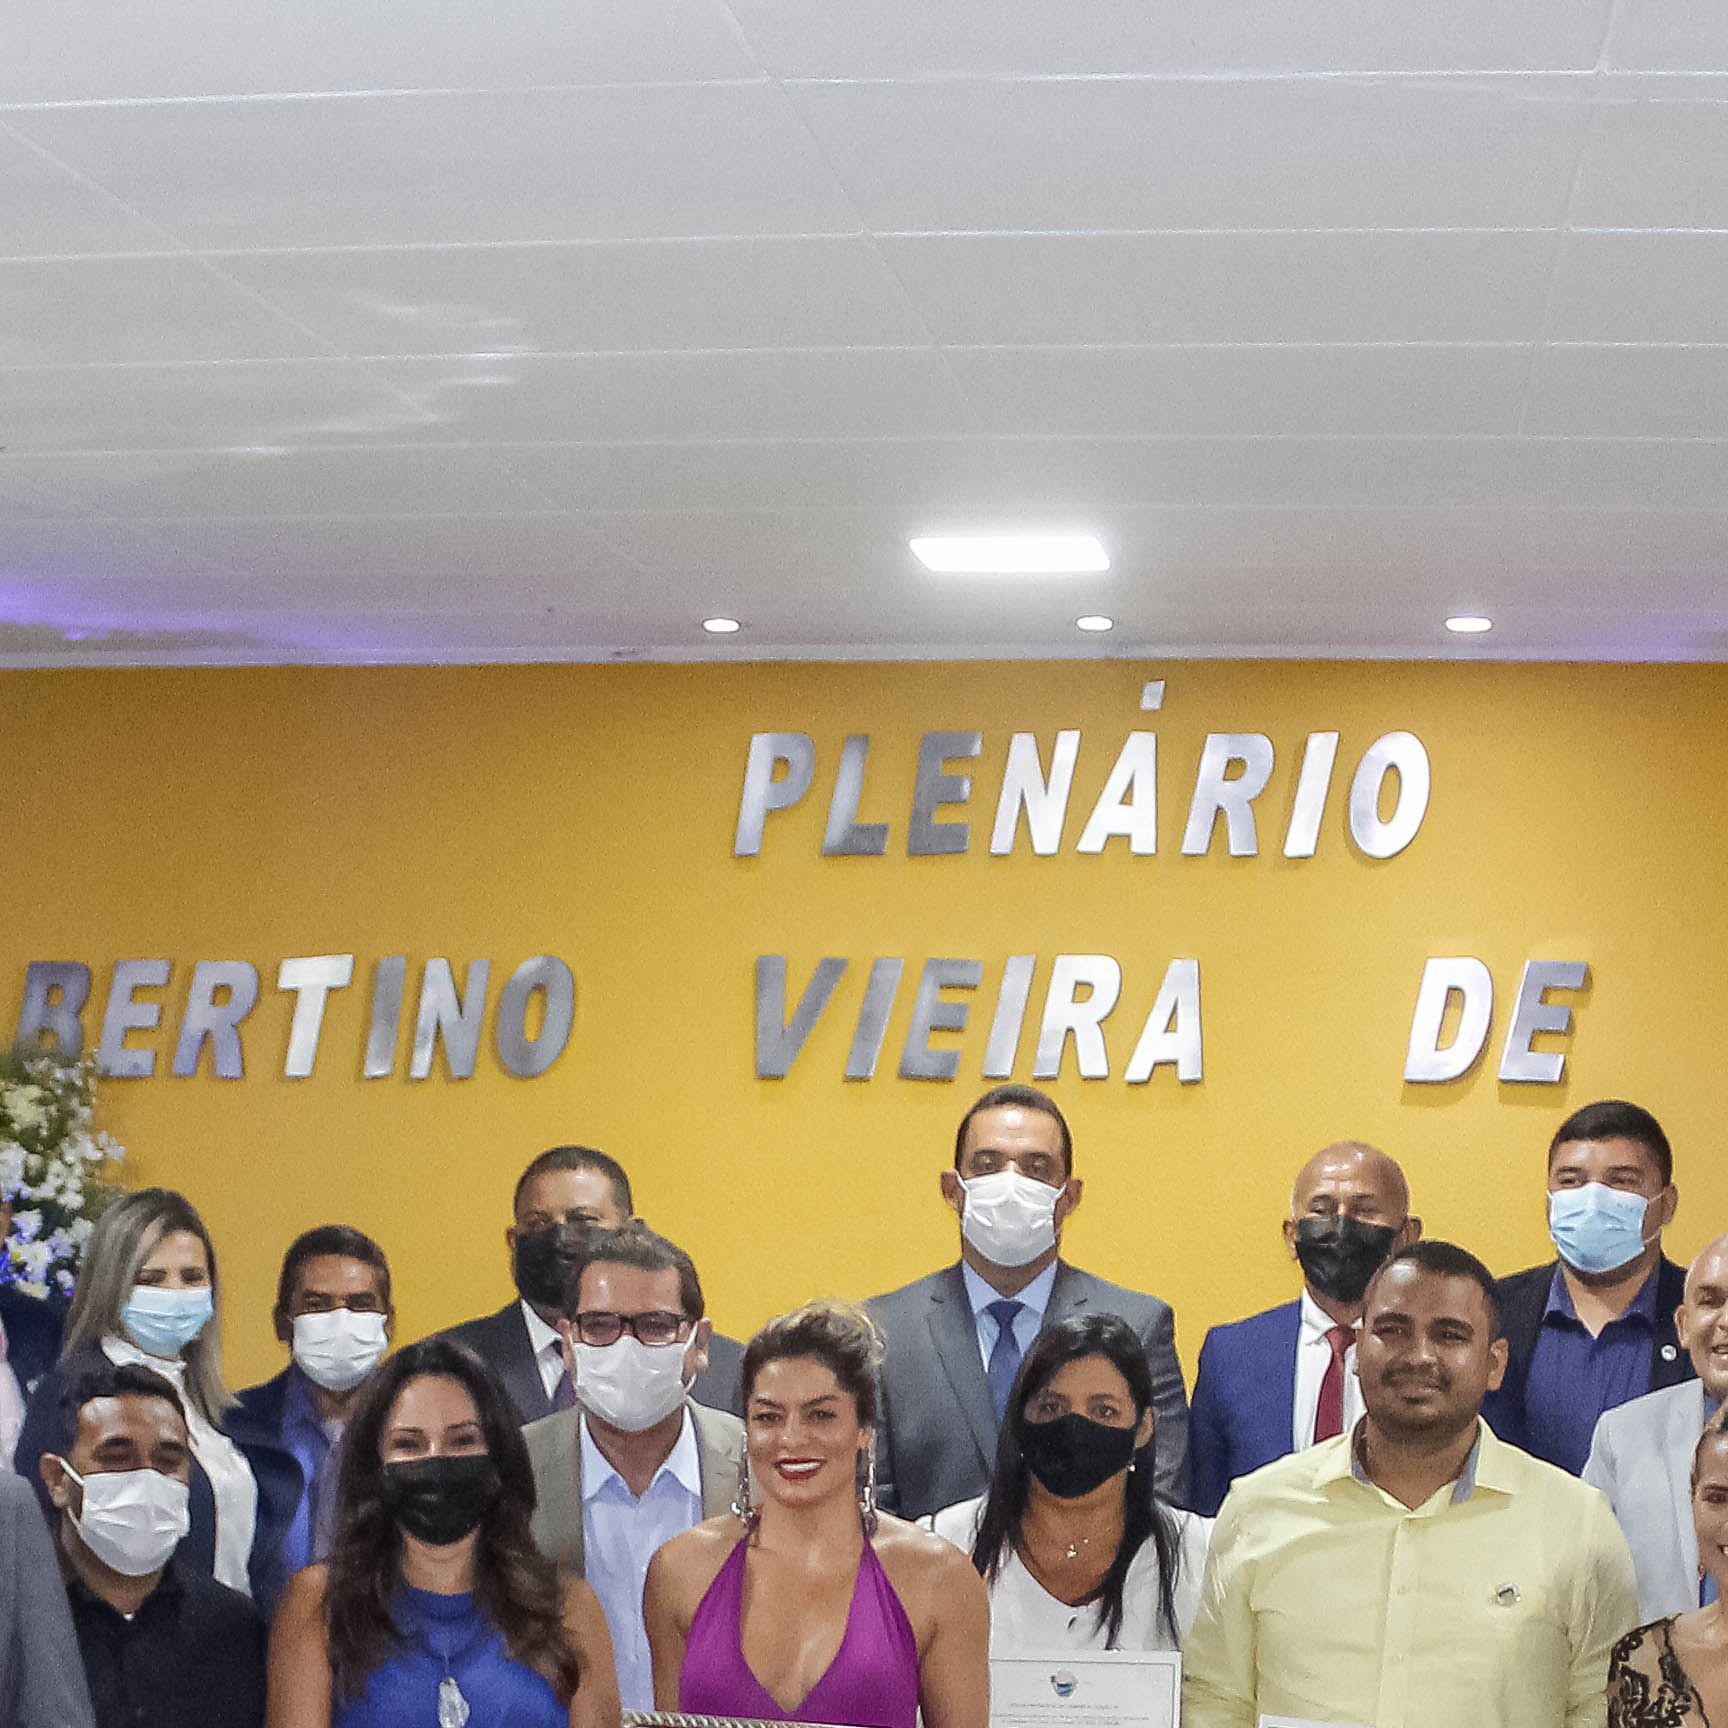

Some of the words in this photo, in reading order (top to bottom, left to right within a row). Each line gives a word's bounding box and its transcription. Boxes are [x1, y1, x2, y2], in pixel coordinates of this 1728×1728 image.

[734, 680, 1431, 858] PLENÁRIO
[756, 954, 1204, 1084] VIEIRA
[1404, 957, 1590, 1085] DE
